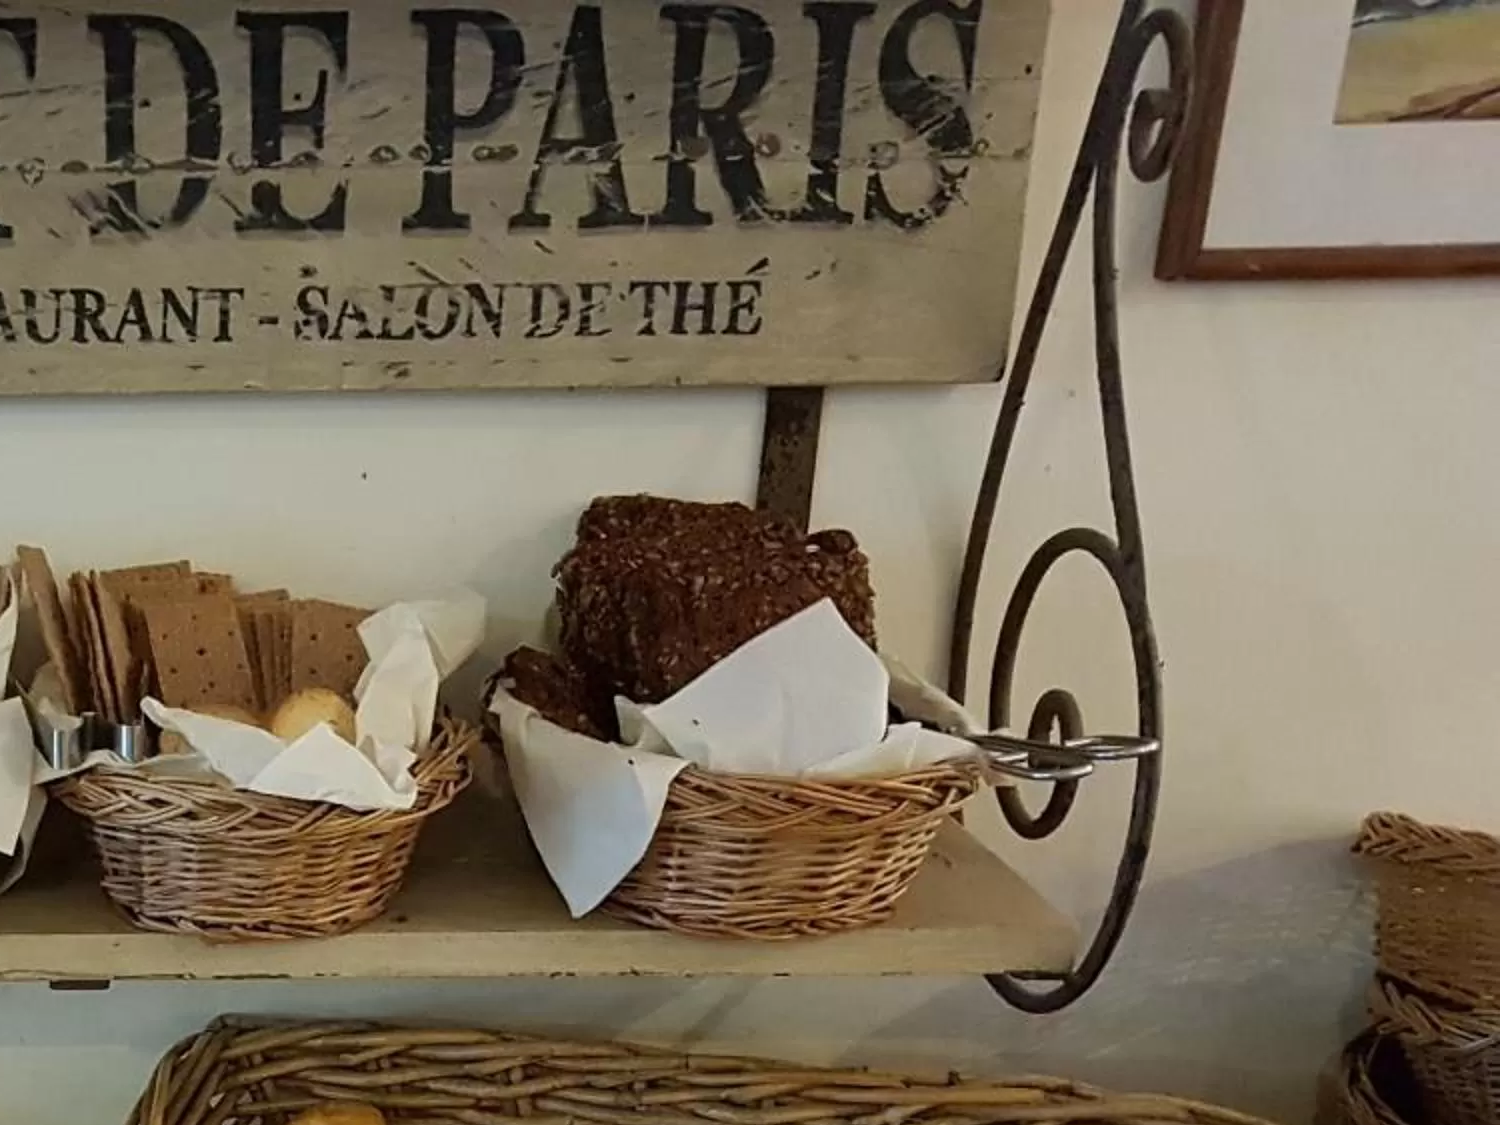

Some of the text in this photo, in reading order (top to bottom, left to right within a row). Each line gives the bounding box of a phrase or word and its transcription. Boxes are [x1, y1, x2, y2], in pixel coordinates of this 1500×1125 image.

[86, 9, 350, 237] DE
[400, 0, 982, 231] PARIS
[295, 281, 503, 341] SALON
[522, 281, 613, 338] DE
[630, 257, 770, 336] THÉ
